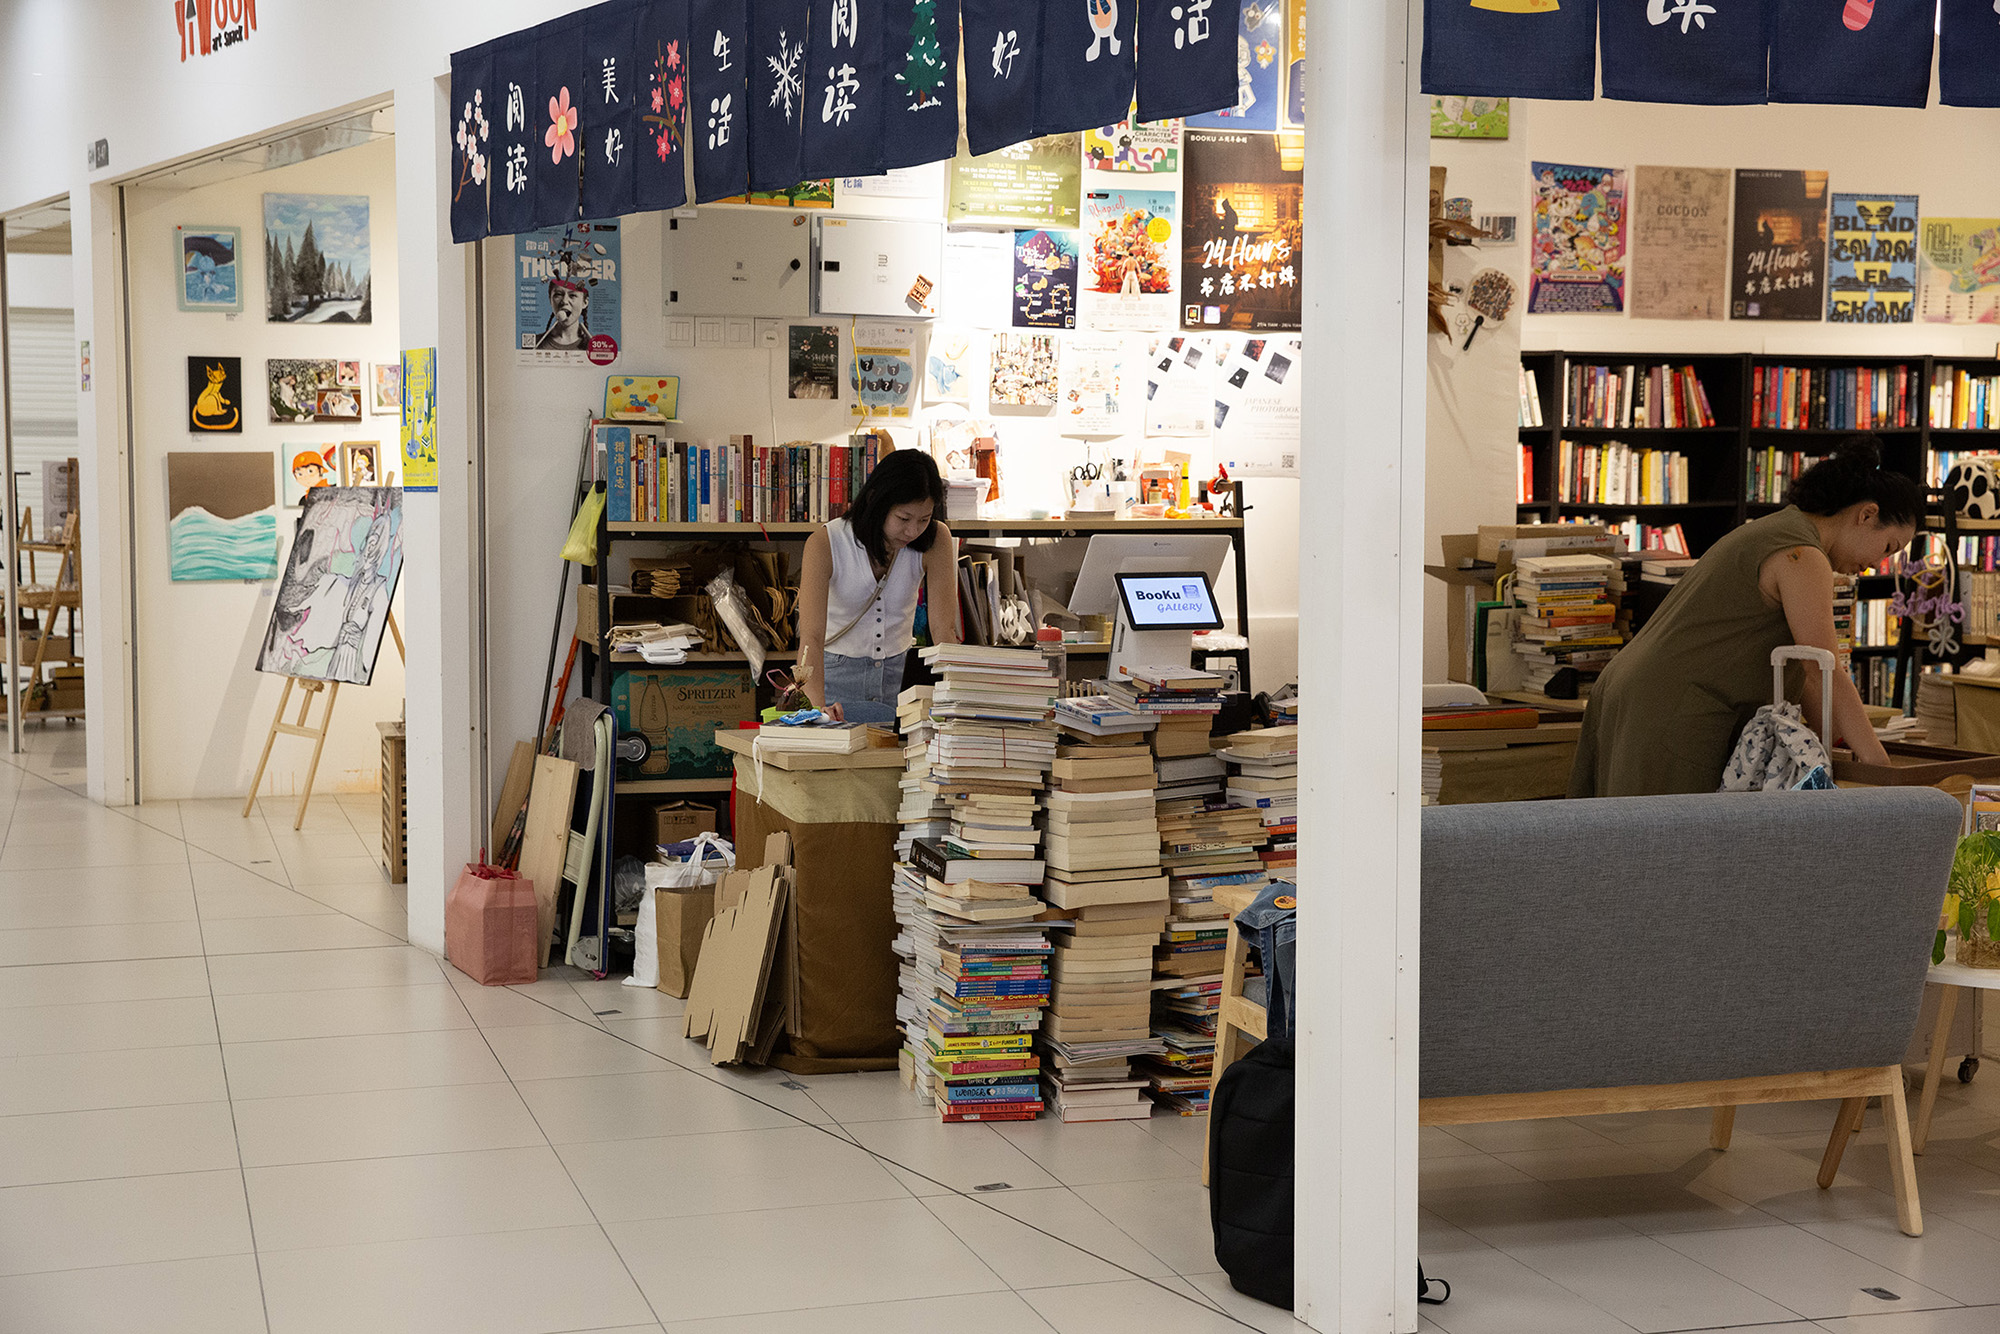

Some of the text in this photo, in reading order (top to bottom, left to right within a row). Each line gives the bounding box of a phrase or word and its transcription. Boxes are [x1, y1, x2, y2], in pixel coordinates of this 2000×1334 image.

[992, 31, 1020, 79] 好
[708, 30, 732, 150] 生活
[602, 57, 623, 167] 美好
[506, 81, 528, 195] 阅读
[1190, 134, 1217, 142] BOOKU
[1202, 233, 1293, 271] 24 Hours
[1746, 246, 1812, 275] 24 Hours
[1200, 265, 1297, 298] 书店不打烊
[1744, 270, 1815, 296] 书店不打烊
[592, 340, 608, 348] 30%
[1250, 405, 1300, 413] PHOTOBOOK
[1135, 590, 1182, 601] BooKu
[677, 687, 736, 702] SPRITZER
[955, 1088, 986, 1098] WONDER
